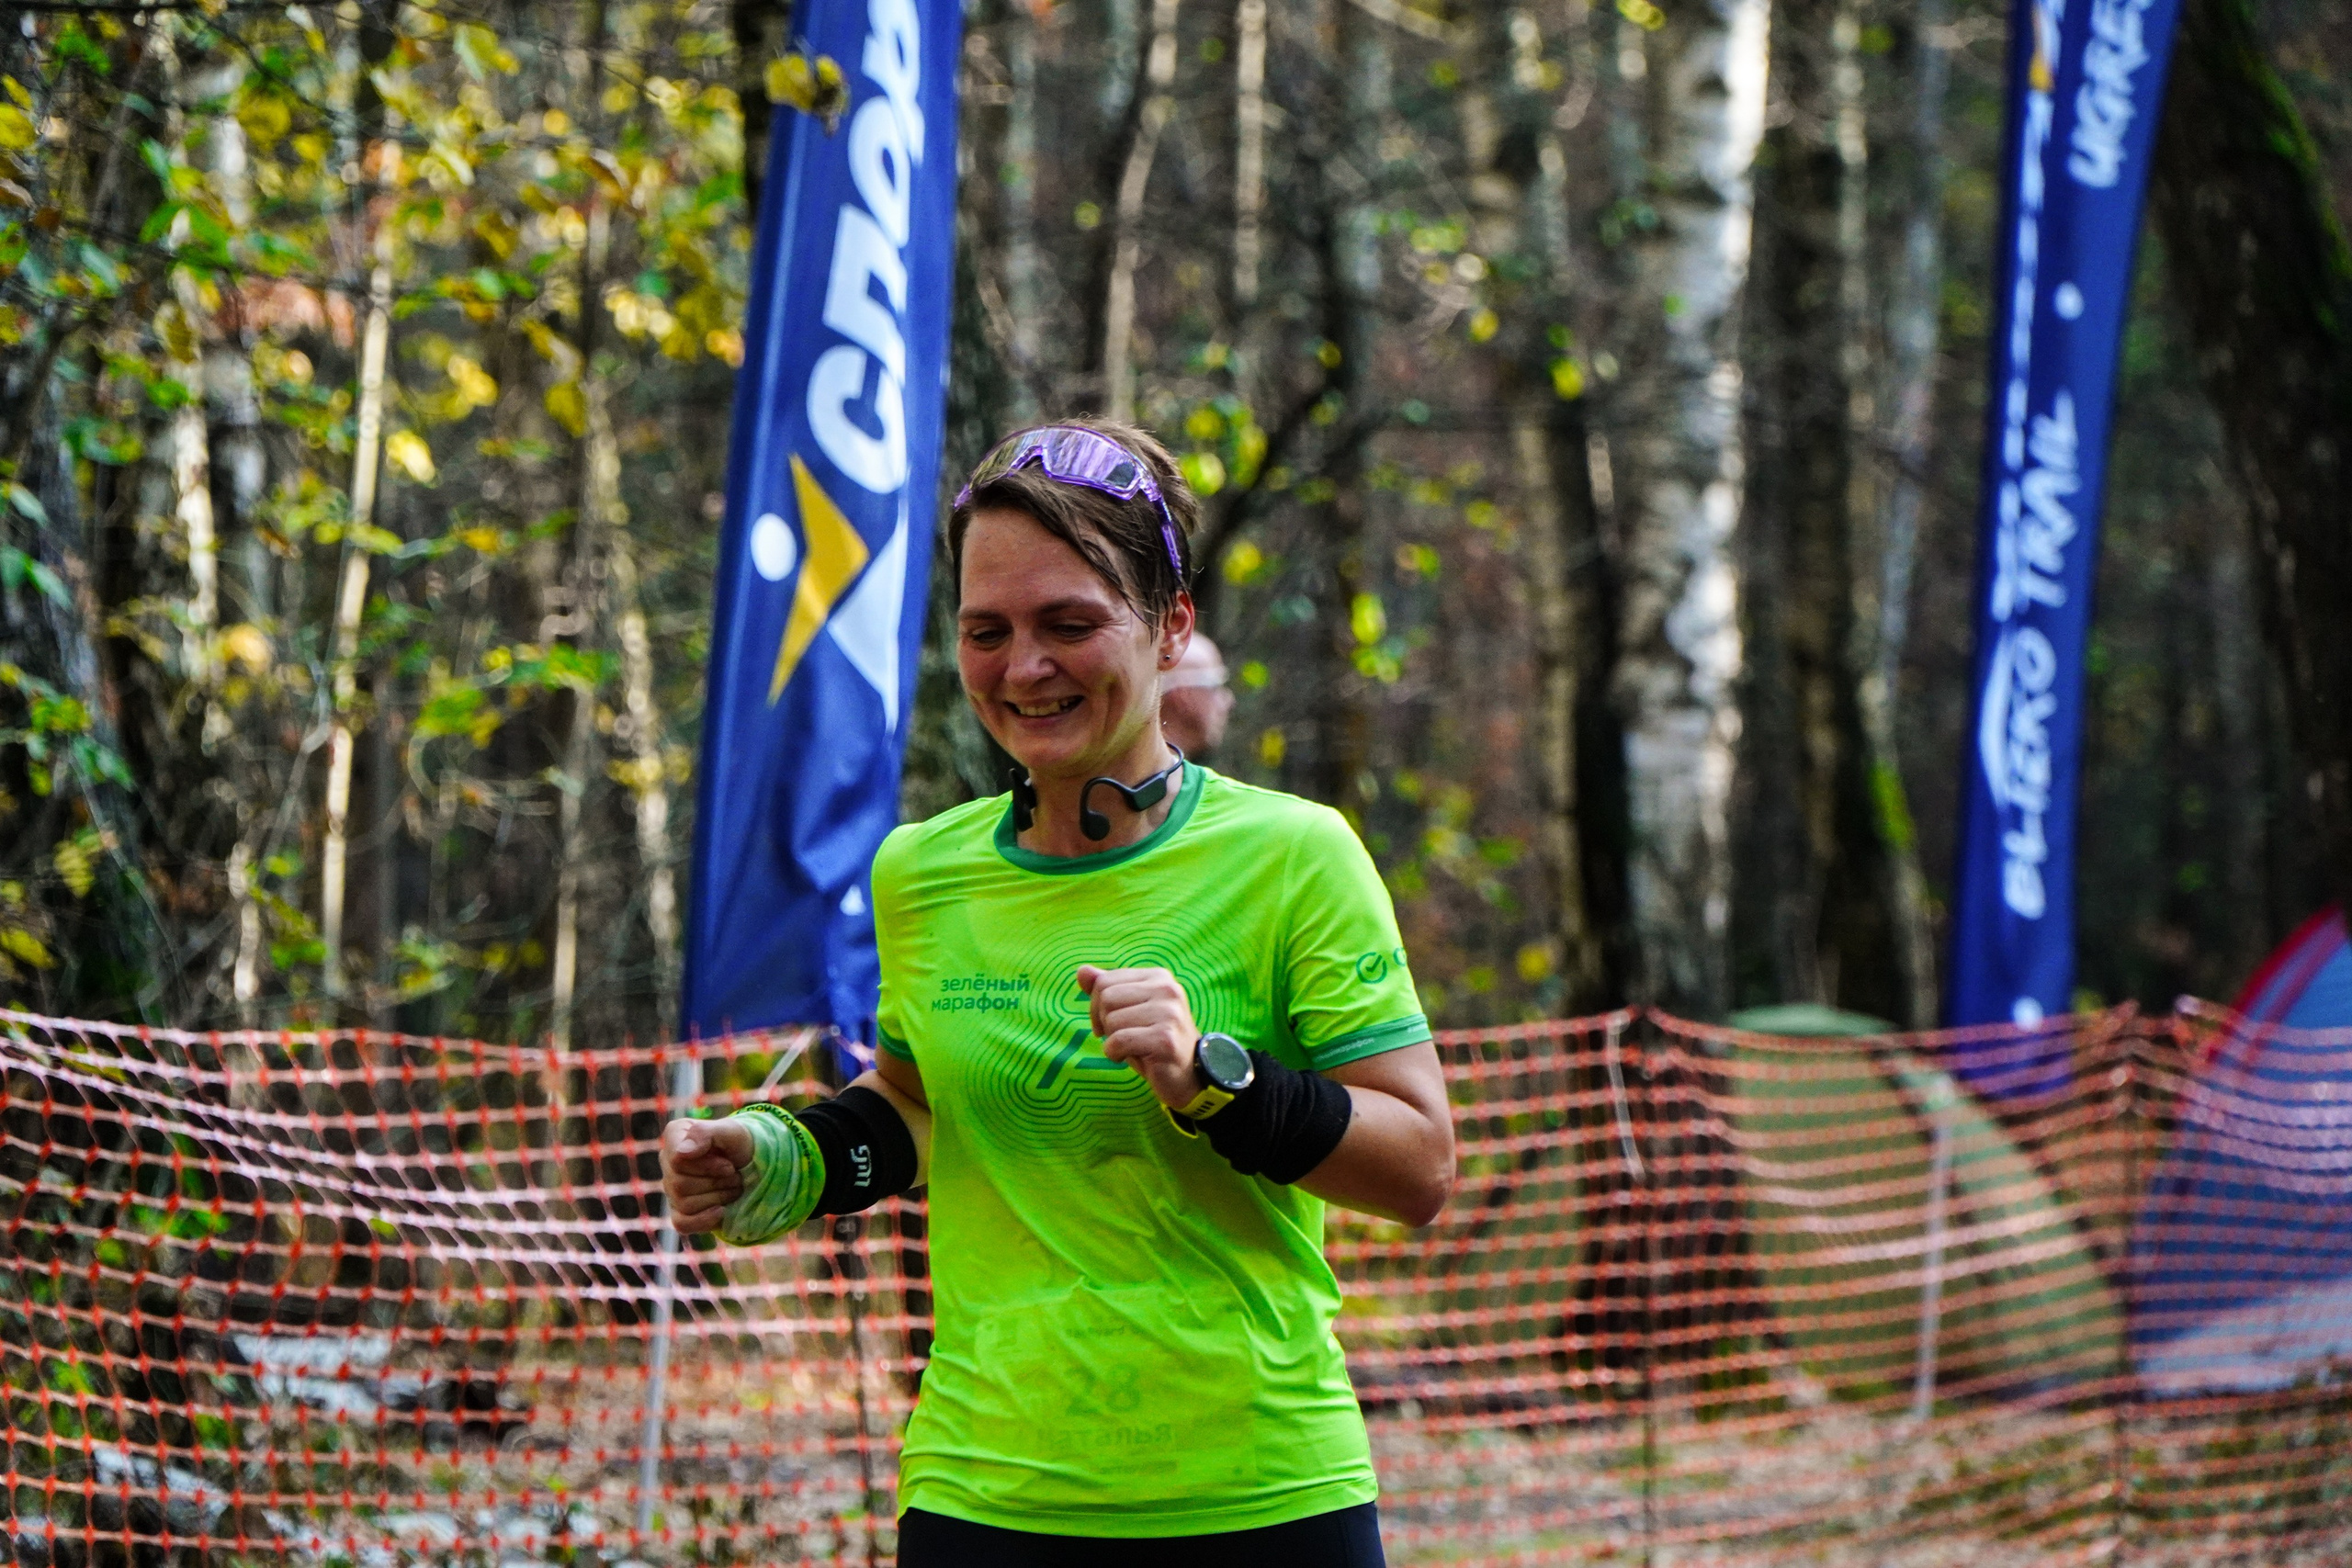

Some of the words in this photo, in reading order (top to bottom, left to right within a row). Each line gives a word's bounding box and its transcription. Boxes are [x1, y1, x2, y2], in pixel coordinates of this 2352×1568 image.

[2066, 0, 2150, 188] UGRE
[940, 973, 1031, 992] зелёный
[931, 992, 1020, 1013] марафон
[1065, 1363, 1141, 1414] 28
